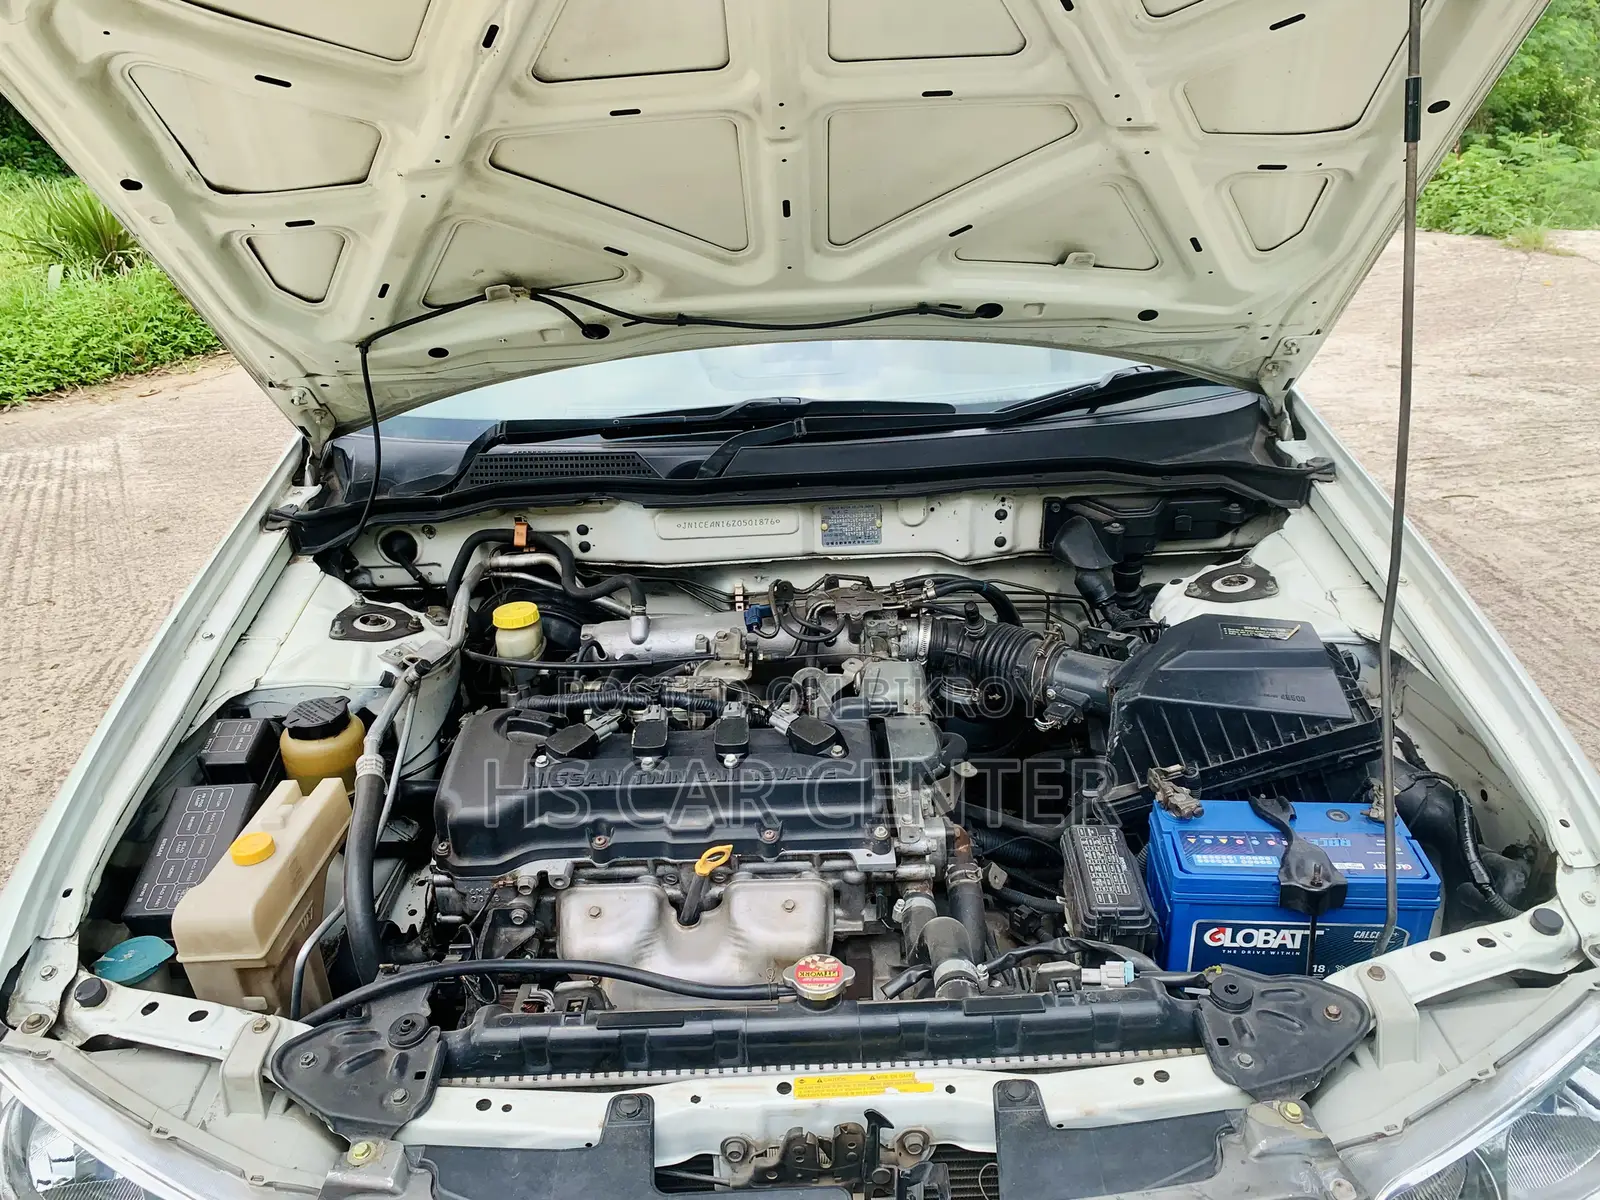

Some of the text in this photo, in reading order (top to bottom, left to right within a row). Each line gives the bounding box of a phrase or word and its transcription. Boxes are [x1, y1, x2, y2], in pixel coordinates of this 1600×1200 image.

[522, 769, 624, 789] NISSAN
[633, 768, 689, 785] TWIN
[1312, 964, 1326, 973] 18
